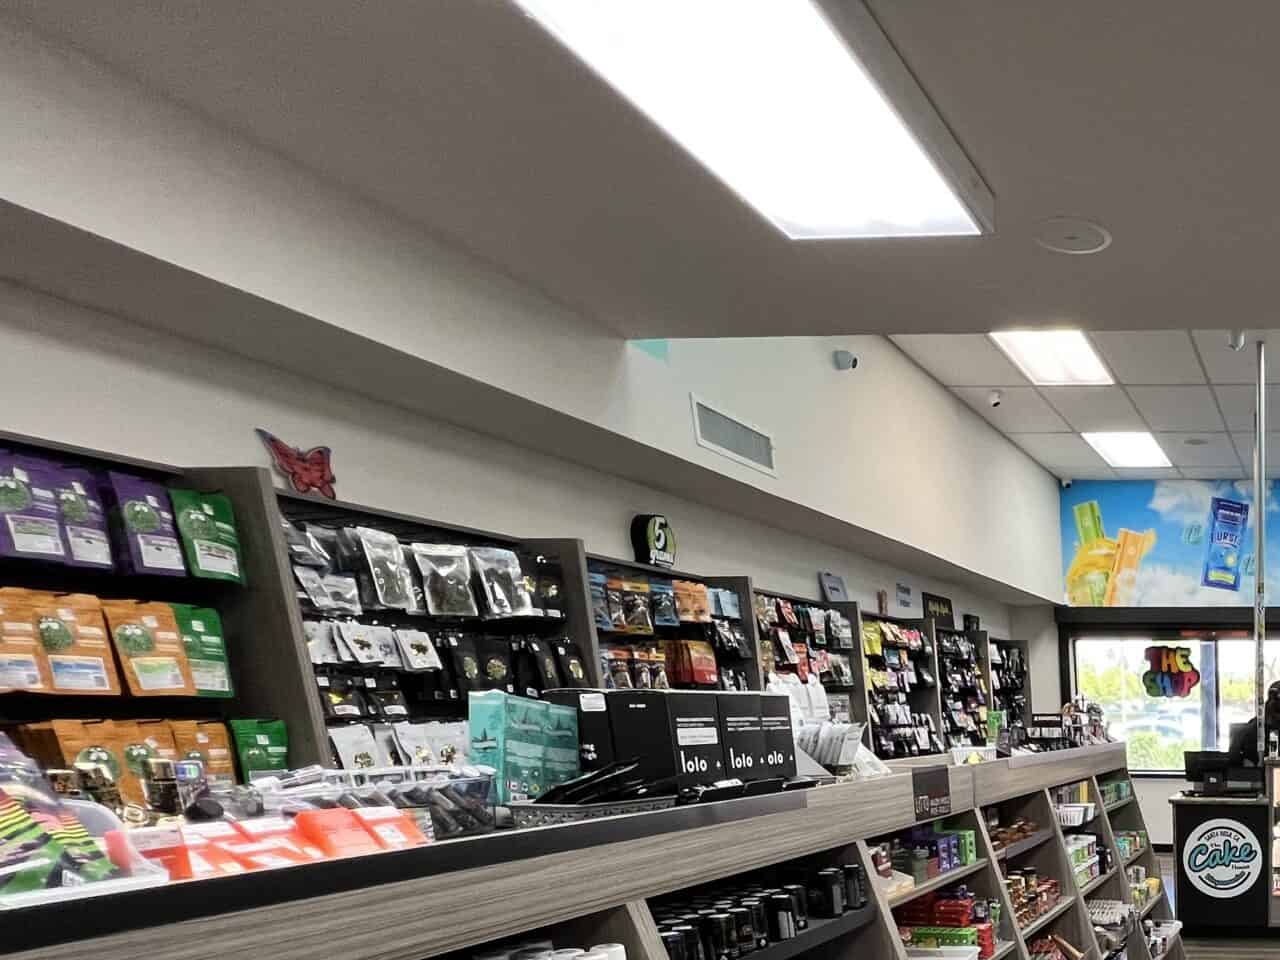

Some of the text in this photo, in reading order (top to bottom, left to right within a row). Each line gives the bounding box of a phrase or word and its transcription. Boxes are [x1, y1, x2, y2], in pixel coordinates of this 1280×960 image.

[655, 516, 666, 550] 5
[1144, 646, 1193, 673] THE
[680, 750, 708, 773] lolo
[730, 747, 753, 769] lolo
[767, 750, 784, 765] olo
[1188, 839, 1258, 872] Cake
